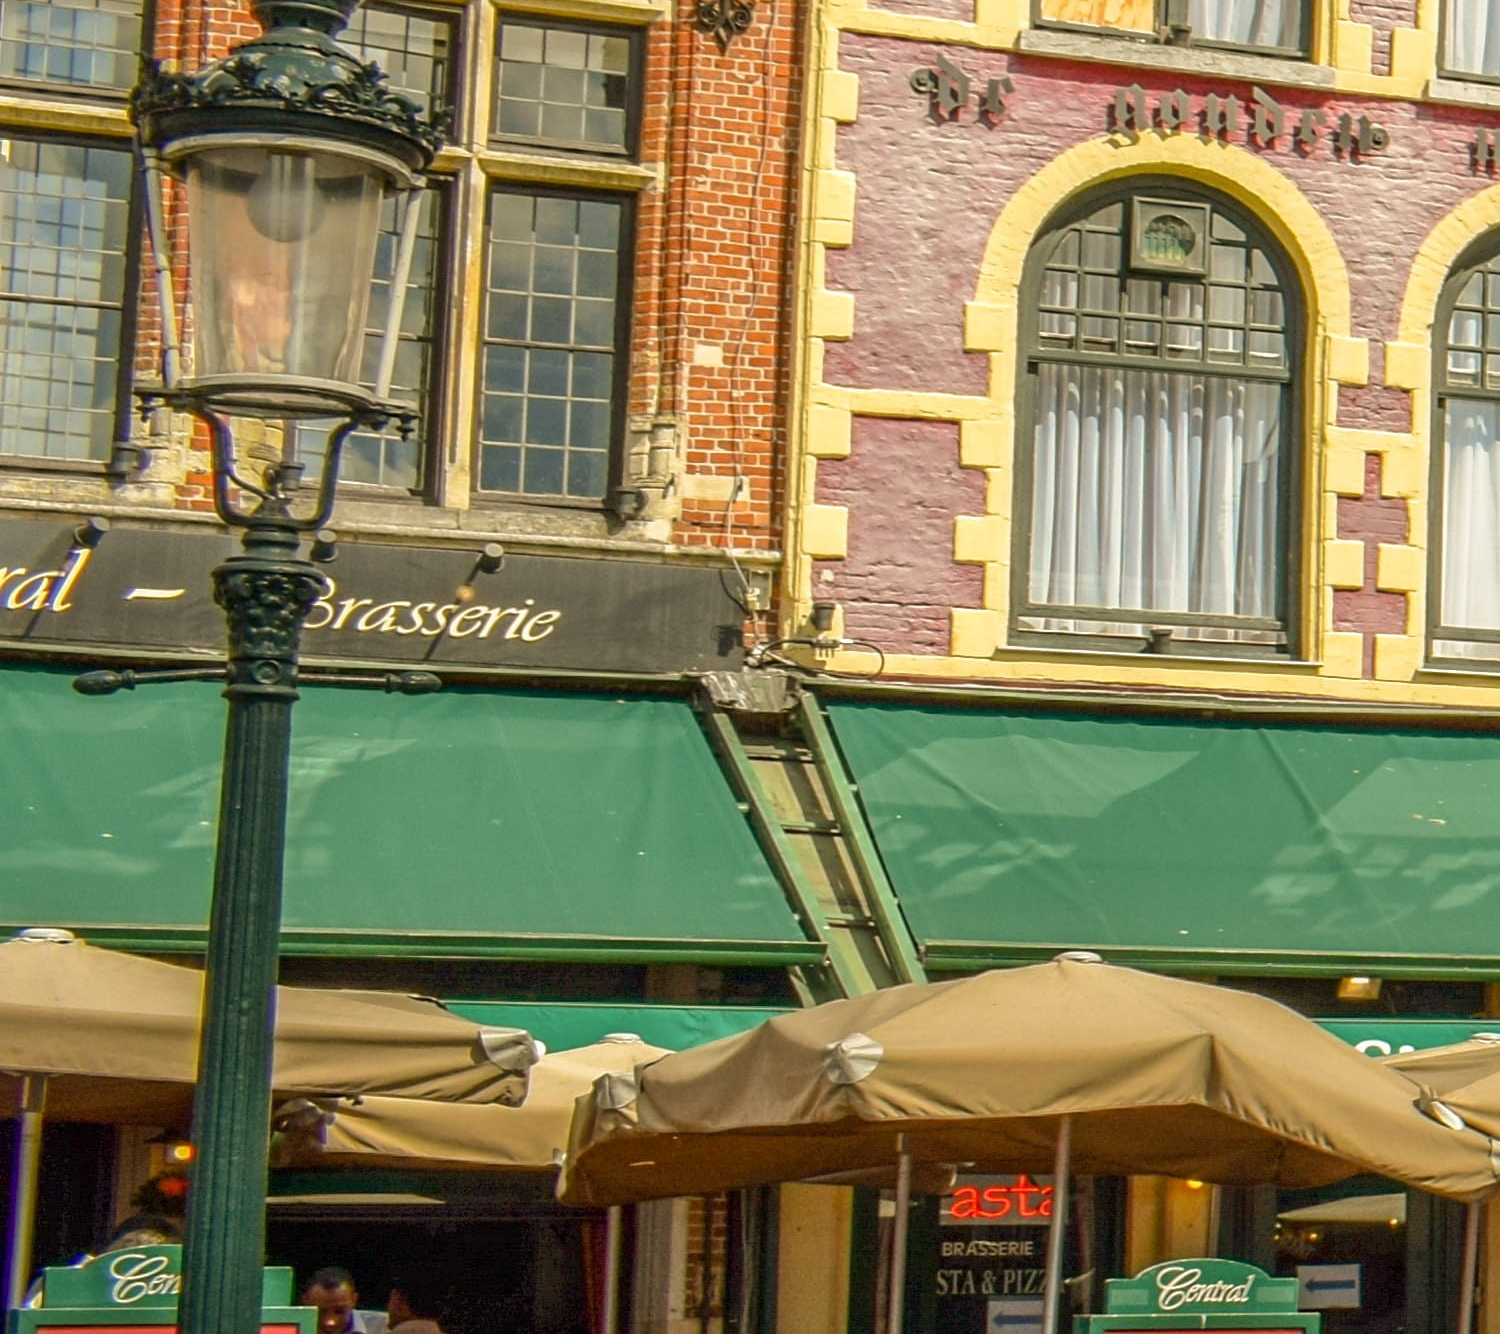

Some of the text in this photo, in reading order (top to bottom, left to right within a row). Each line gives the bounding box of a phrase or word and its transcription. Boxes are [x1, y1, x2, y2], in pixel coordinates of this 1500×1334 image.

[941, 1241, 1034, 1256] BRASSERIE
[981, 1269, 997, 1294] &
[1157, 1267, 1255, 1310] Central
